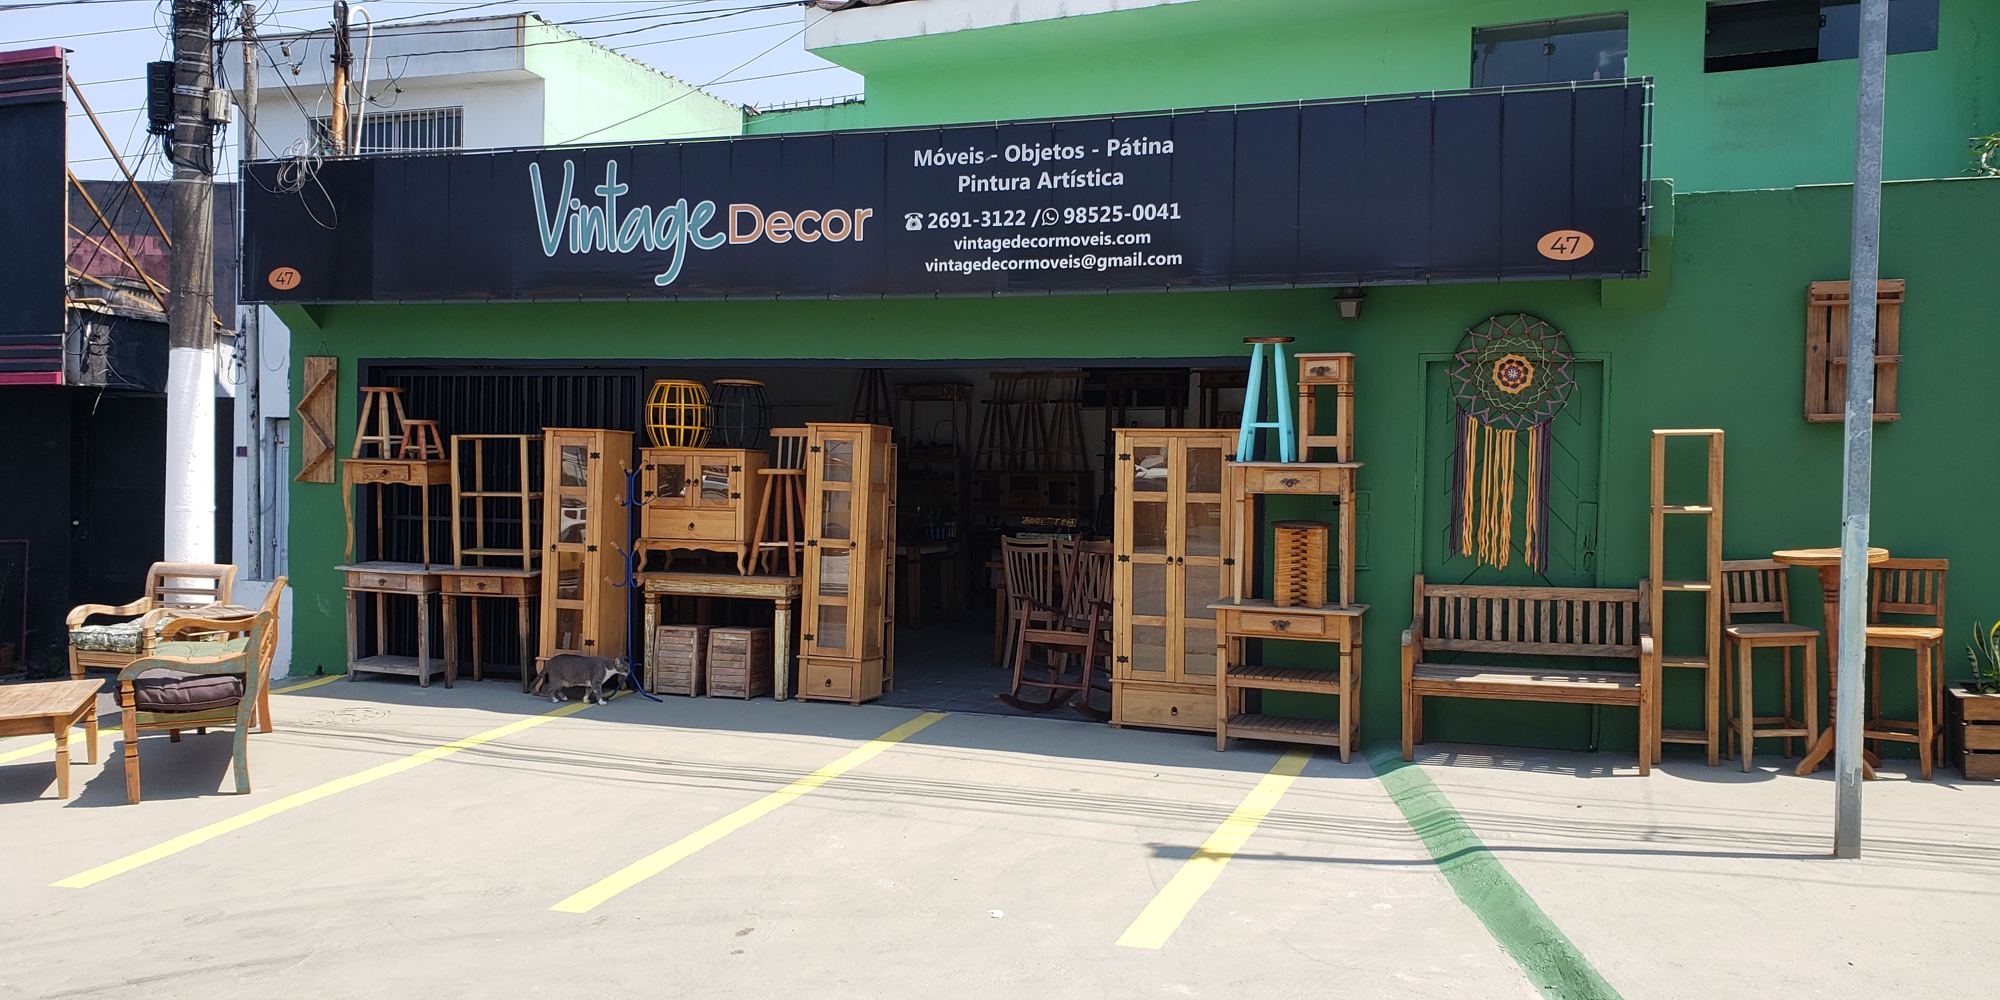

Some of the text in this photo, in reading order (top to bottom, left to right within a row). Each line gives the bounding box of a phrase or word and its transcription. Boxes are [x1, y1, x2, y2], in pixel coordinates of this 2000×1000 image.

[913, 146, 984, 167] Móveis
[1004, 142, 1085, 167] Objetos
[1107, 136, 1174, 157] Pátina
[958, 167, 1124, 193] Pintura Artística
[528, 159, 874, 287] Vintage Decor
[927, 209, 1026, 229] 2691-3122
[1063, 202, 1182, 225] 98525-0041
[953, 230, 1151, 253] vintagedecormoveis.com
[1550, 236, 1580, 255] 47
[924, 251, 1183, 276] vintagedecormoveis@gmail.com
[275, 271, 294, 286] 47
